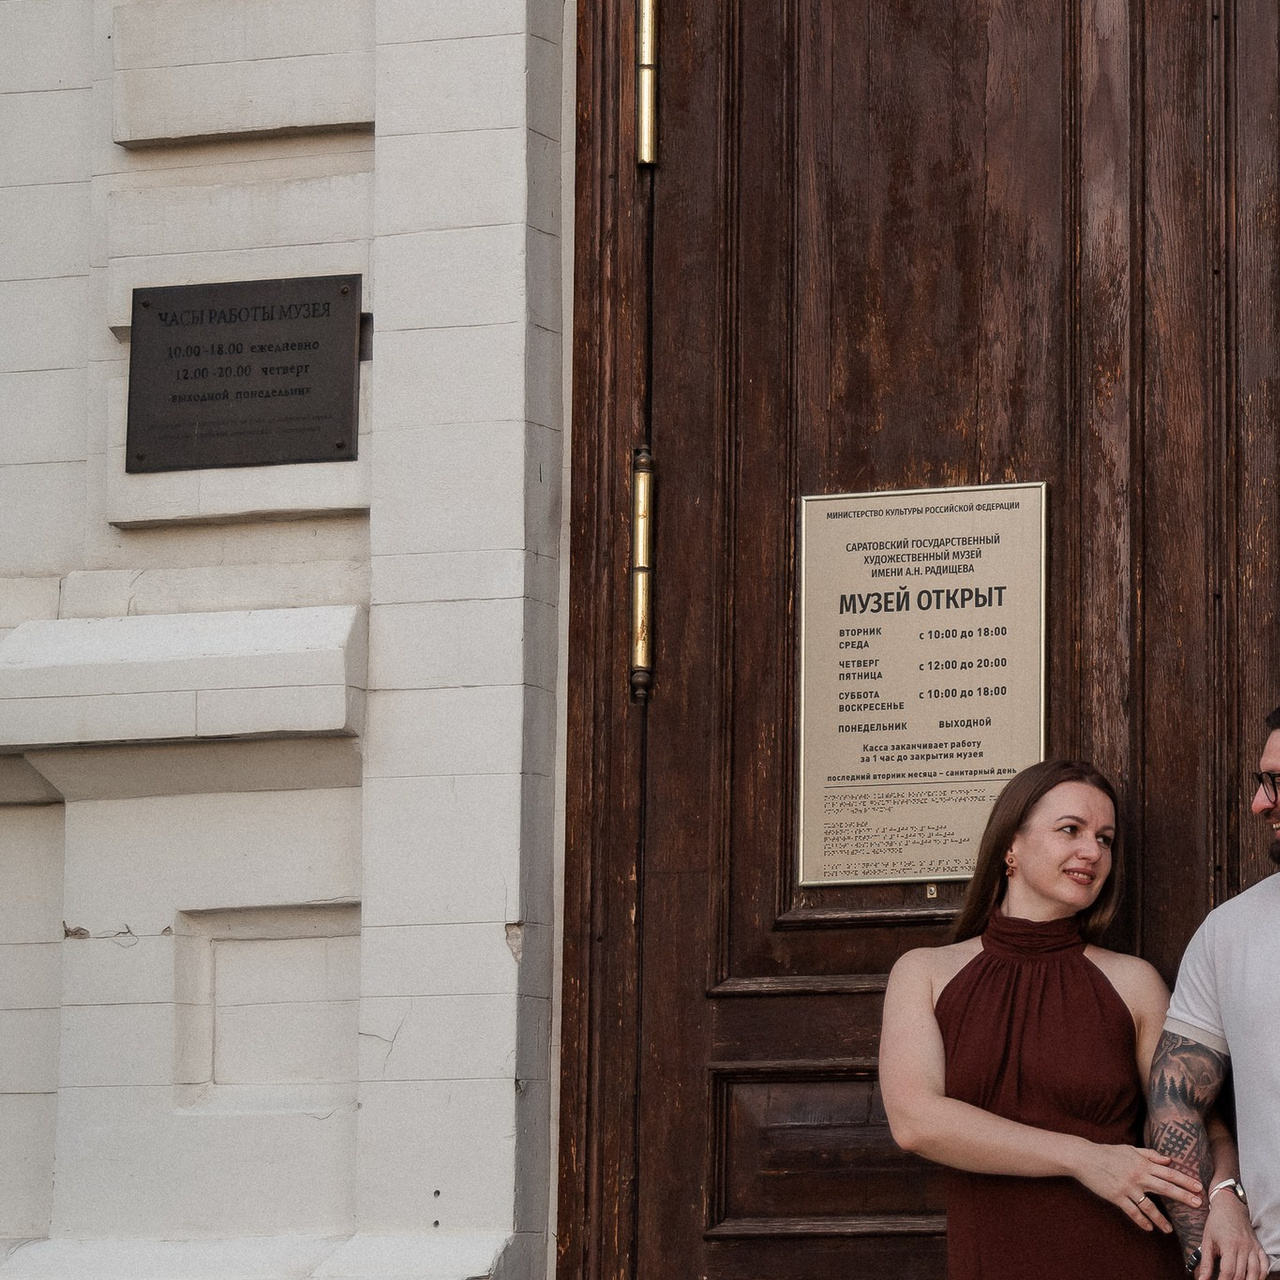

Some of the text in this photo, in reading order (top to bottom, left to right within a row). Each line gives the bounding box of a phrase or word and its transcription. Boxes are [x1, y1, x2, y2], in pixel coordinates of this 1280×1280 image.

[158, 302, 331, 327] ЧАСЫ РАБОТЫ МУЗЕЯ
[250, 340, 319, 353] ежедневно
[261, 364, 310, 377] четверг
[170, 387, 312, 404] выходной понедельник
[826, 501, 1020, 519] МИНИСТЕРСТВО КУЛЬТУРЫ РОССИЙСКОЙ ФЕДЕРАЦИИ
[845, 533, 1000, 552] САРАТОВСКИЙ ГОСУДАРСТВЕННЫЙ
[863, 547, 982, 566] ХУДОЖЕСТВЕННЫЙ МУЗЕЙ
[871, 564, 974, 578] ИМЕНИ А.Н. РАДИЩЕВА
[839, 585, 1007, 615] МУЗЕЙ ОТКРЫТ
[839, 627, 882, 637] ВТОРНИК
[919, 626, 1007, 640] с 10:00 до 18:00
[839, 641, 869, 649] СРЕДА
[839, 659, 880, 668] ЧЕТВЕРГ
[919, 658, 1007, 671] с 12:00 до 20:00
[839, 671, 883, 681] ПЯТНИЦА
[839, 691, 880, 700] СУББОТА
[919, 686, 1007, 699] с 10:00 до 18:00
[839, 702, 904, 712] ВОСКРЕСЕНЬЕ
[838, 722, 908, 733] ПОНЕДЕЛЬНИК
[939, 717, 992, 729] ВЫХОДНОЙ
[863, 740, 982, 752] Касса заканчивает работу
[860, 751, 983, 763] за 1 час до закрытия музея
[827, 773, 871, 782] последний
[872, 772, 906, 780] вторник
[908, 770, 937, 779] месяца
[945, 768, 995, 777] санитарный
[997, 767, 1017, 775] день
